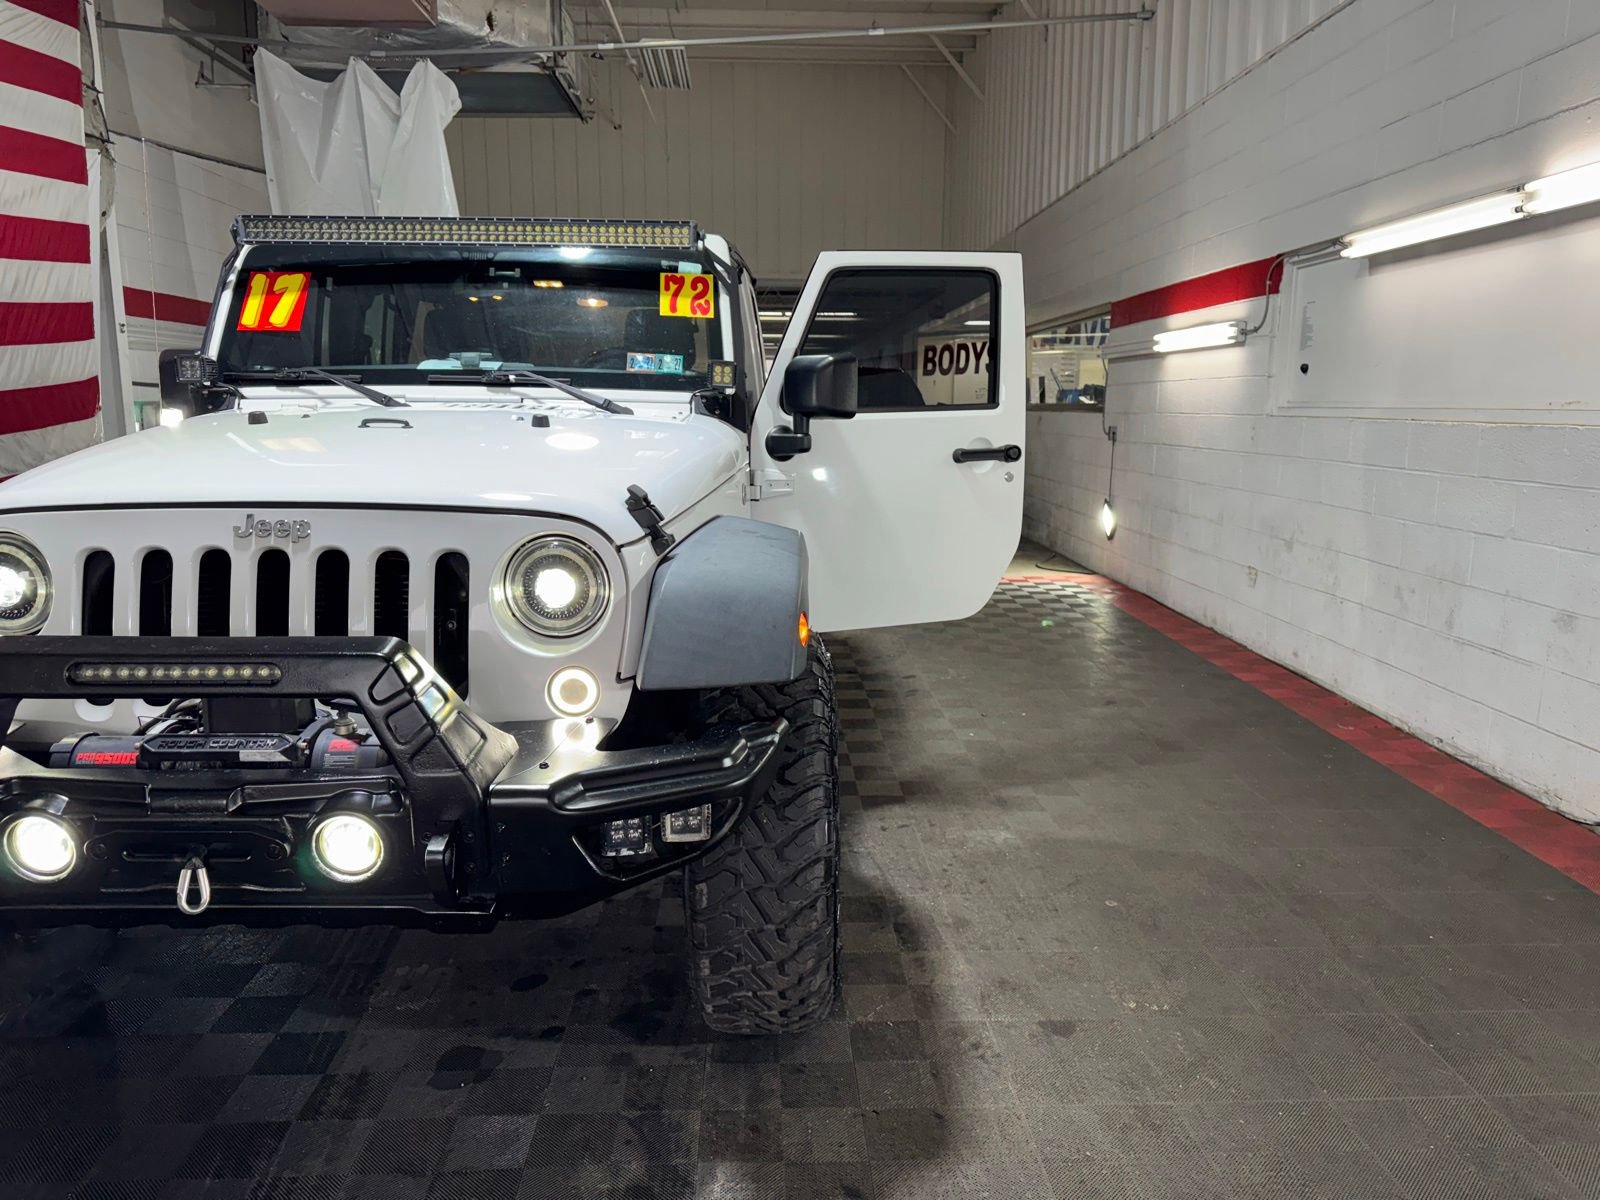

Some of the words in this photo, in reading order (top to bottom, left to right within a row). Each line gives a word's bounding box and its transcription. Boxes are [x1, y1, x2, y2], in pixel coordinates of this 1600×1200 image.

[240, 273, 306, 328] 17
[664, 274, 710, 316] 72
[922, 341, 989, 376] BODY
[233, 513, 311, 543] Jeep
[209, 739, 277, 750] COUNTRY
